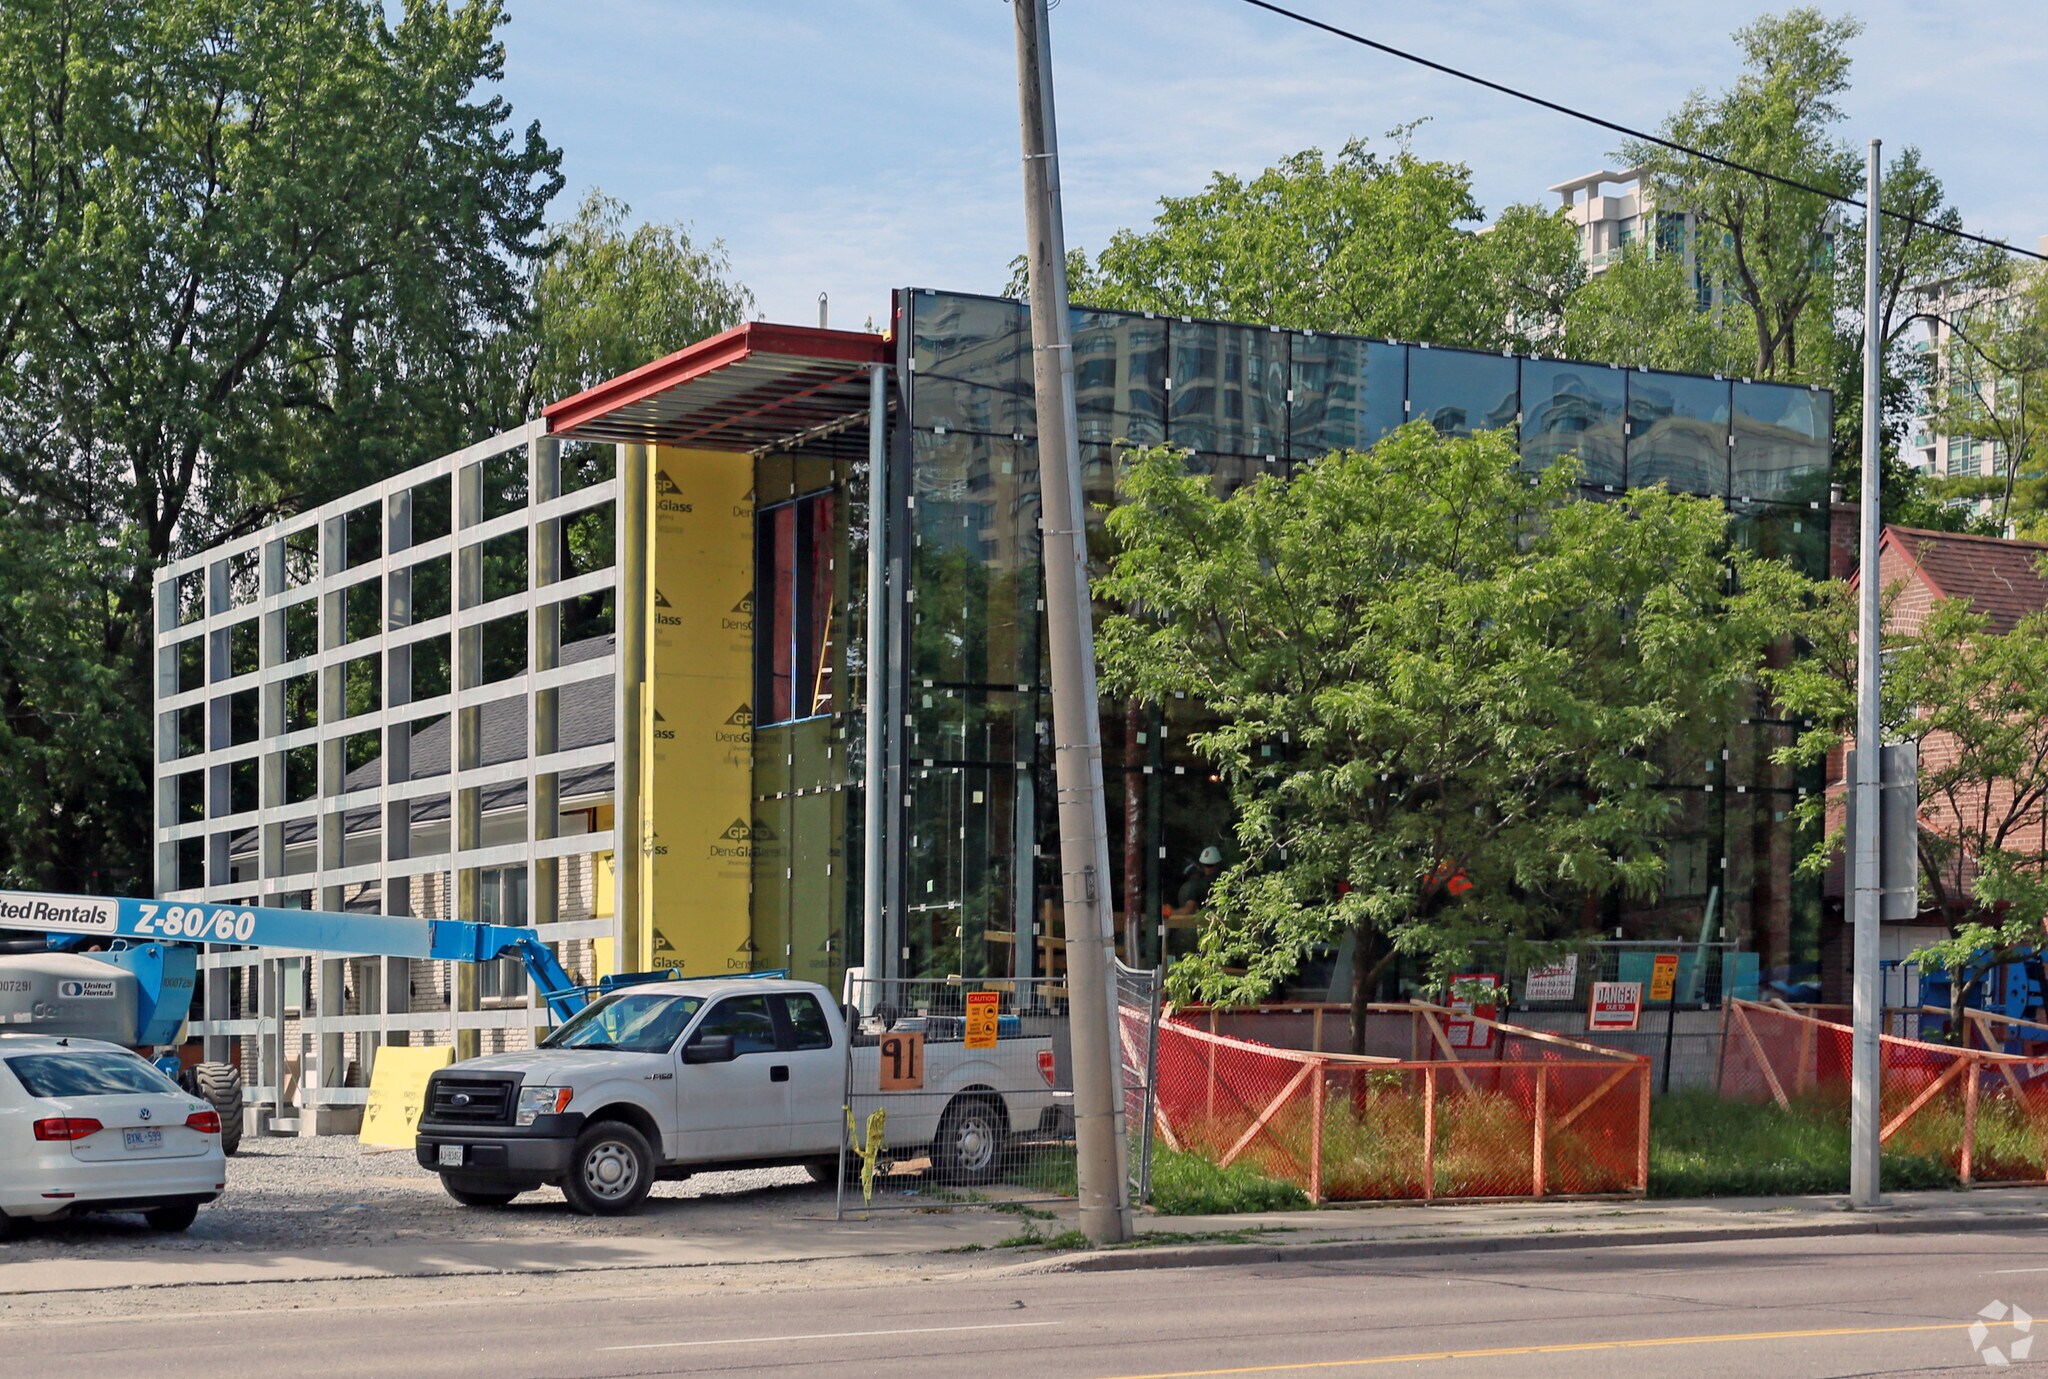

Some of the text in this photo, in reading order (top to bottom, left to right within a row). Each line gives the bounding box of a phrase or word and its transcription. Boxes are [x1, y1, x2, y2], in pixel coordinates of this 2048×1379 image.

[655, 613, 682, 626] lass
[728, 827, 749, 839] GP
[33, 904, 107, 924] Rentals
[134, 904, 256, 941] Z-80/60
[653, 956, 685, 968] Glass
[969, 995, 997, 1003] CAUTION
[1598, 986, 1637, 1004] DANGER
[882, 1038, 916, 1079] 91
